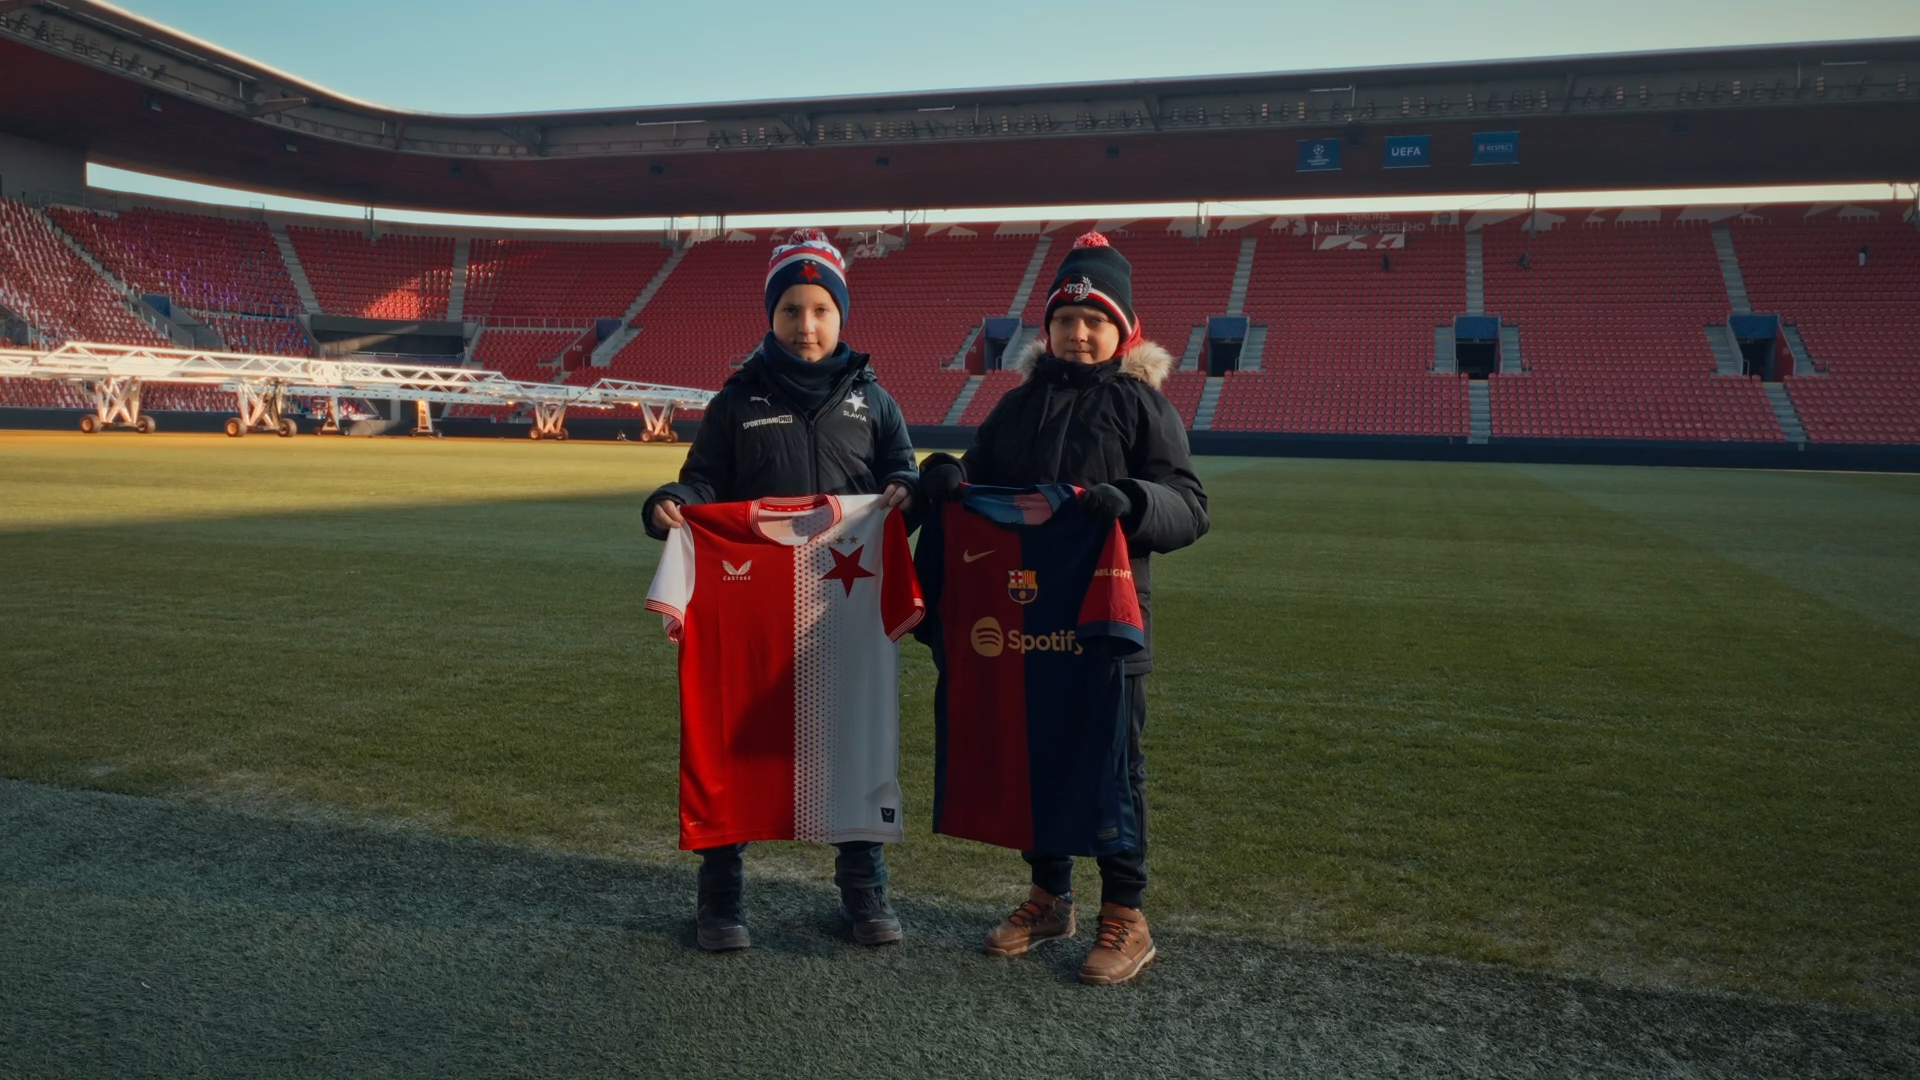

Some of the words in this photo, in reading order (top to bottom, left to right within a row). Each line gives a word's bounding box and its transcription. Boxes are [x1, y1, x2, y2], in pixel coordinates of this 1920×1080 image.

[1391, 147, 1421, 156] UEFA
[1486, 144, 1513, 152] RESPECT
[843, 410, 867, 422] SLAVIA
